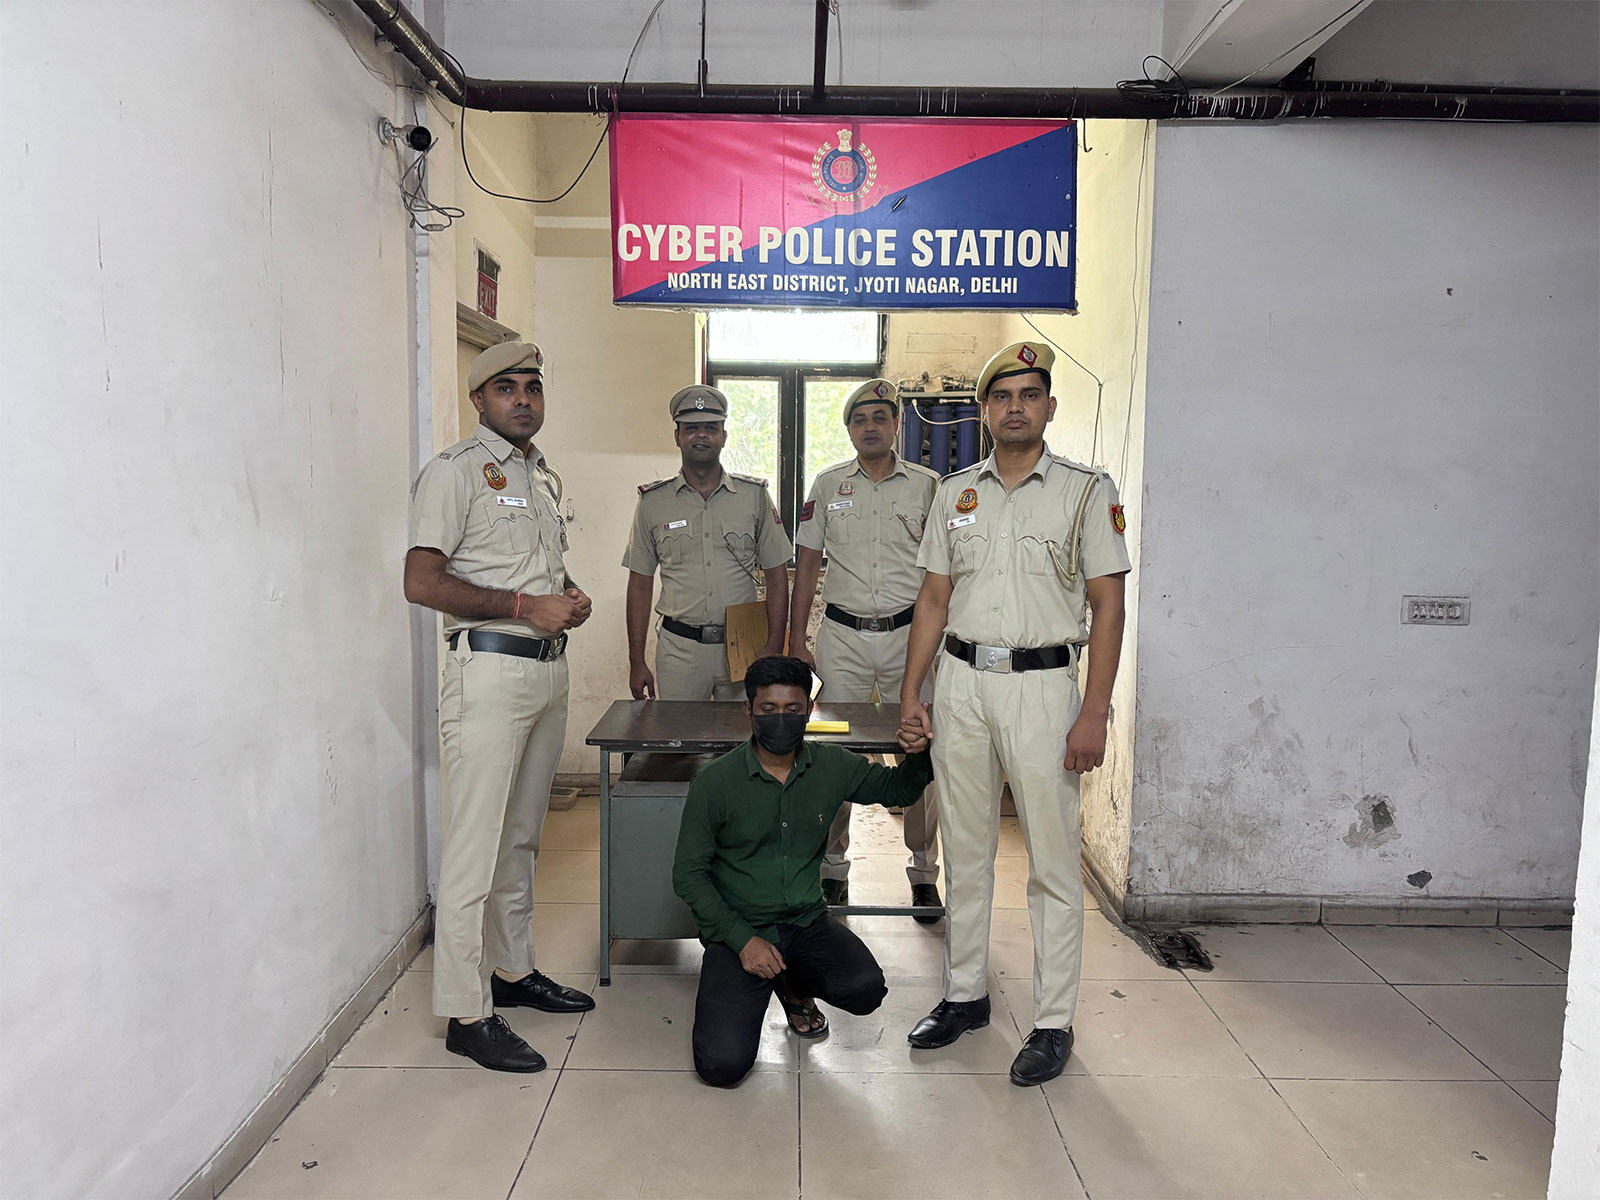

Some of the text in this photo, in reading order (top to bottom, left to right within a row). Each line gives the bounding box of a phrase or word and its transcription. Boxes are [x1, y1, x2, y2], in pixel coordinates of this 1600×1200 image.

[617, 223, 1070, 268] CYBER POLICE STATION
[479, 281, 496, 313] EXIT
[667, 271, 1018, 296] NORTH EAST DISTRICT, JYOTI NAGAR, DELHI
